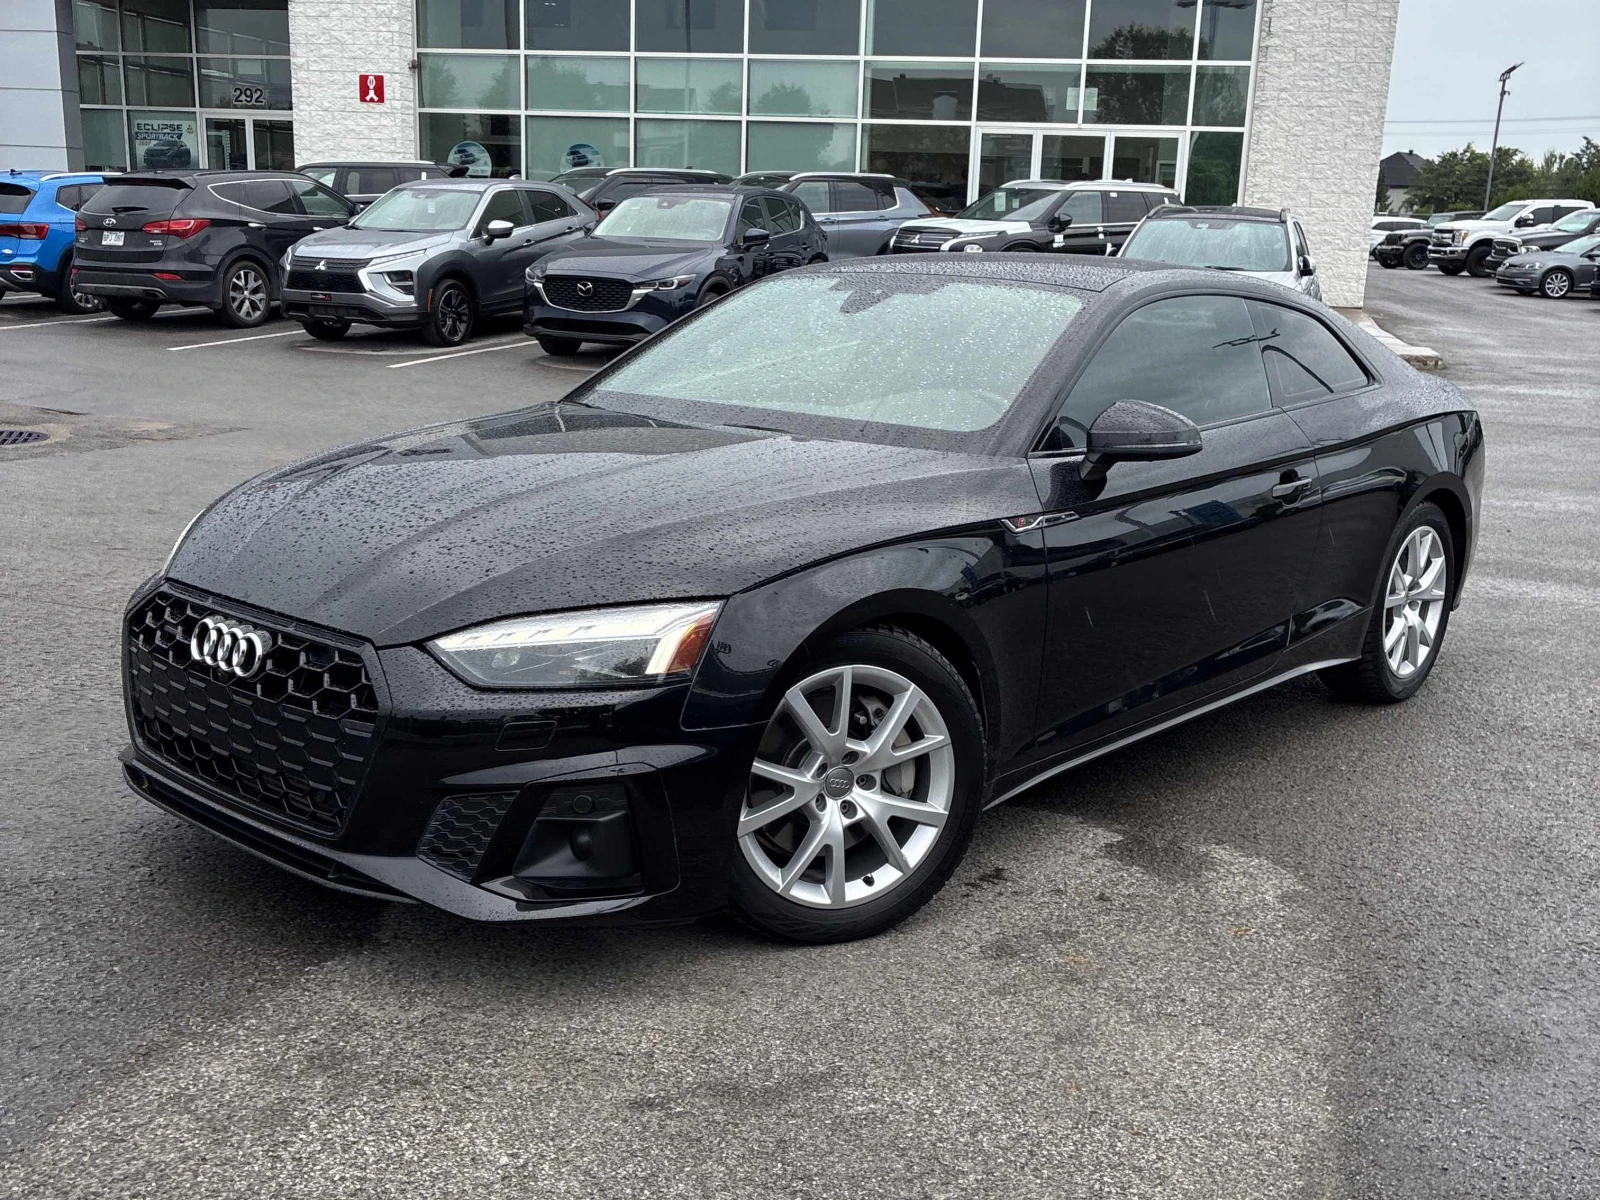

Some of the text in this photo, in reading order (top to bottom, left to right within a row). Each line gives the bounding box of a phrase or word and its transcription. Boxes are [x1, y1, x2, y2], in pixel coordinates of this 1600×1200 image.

[233, 87, 264, 104] 292
[136, 122, 184, 132] ECLIPSE
[136, 132, 180, 140] SPORTBACK
